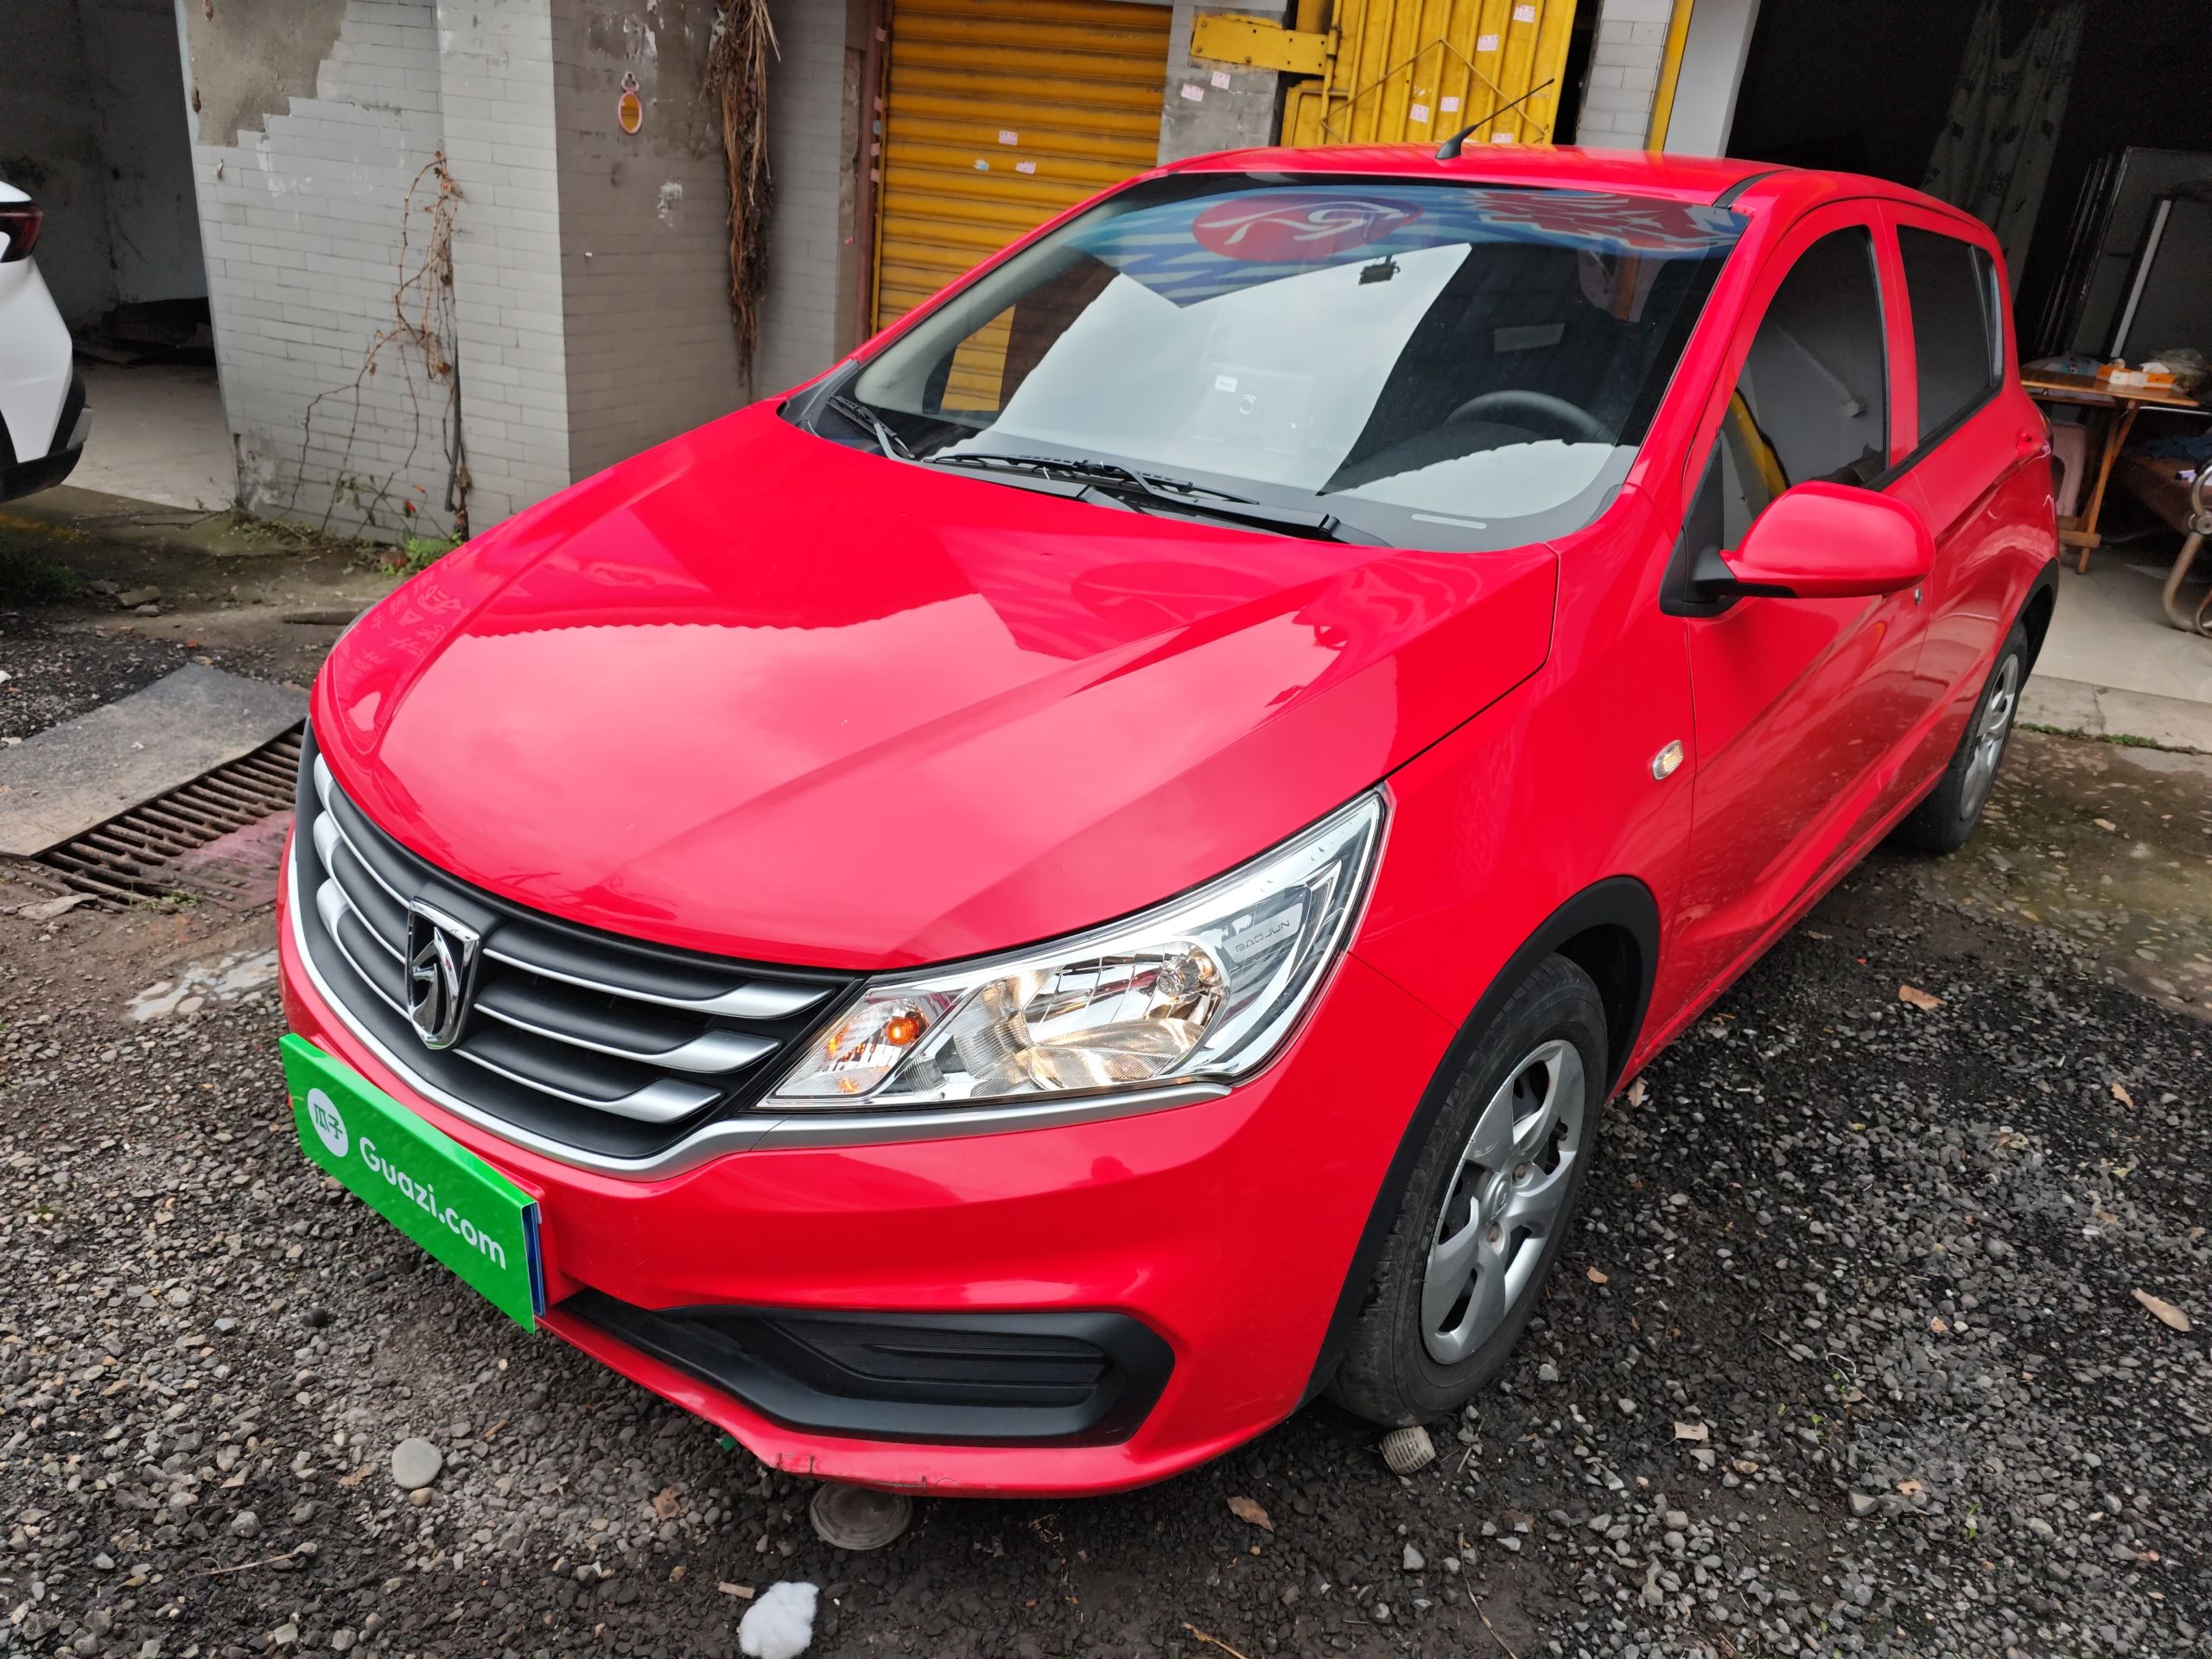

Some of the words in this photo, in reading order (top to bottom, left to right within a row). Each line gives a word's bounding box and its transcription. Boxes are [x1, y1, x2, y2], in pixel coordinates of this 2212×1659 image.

[1235, 919, 1290, 953] BAOJUN
[312, 1102, 344, 1141] 瓜子
[359, 1136, 506, 1270] Guazi.com
